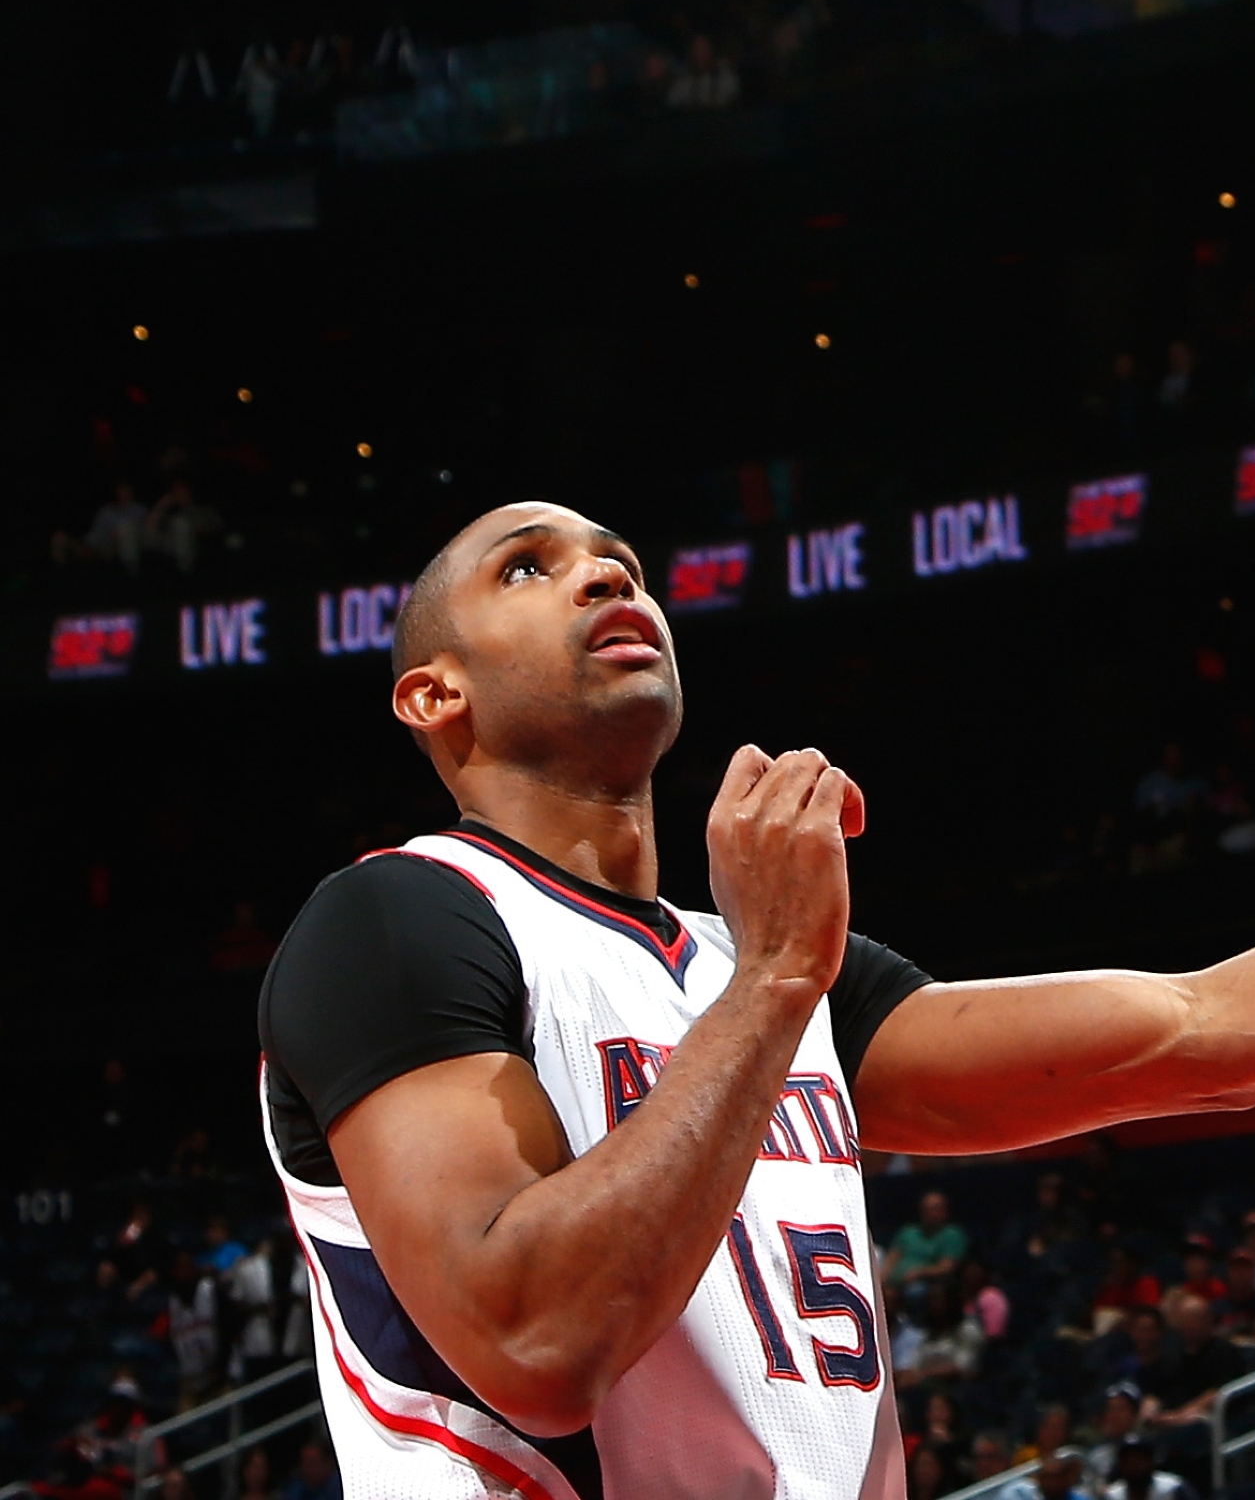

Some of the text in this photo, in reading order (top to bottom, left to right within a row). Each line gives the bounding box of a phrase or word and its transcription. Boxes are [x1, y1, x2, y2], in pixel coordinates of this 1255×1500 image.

[784, 520, 868, 599] LIVE
[911, 491, 1032, 578] LOCAL
[178, 596, 269, 671] LIVE
[316, 581, 414, 657] LOC
[14, 1189, 74, 1225] 101
[726, 1211, 880, 1392] 15
